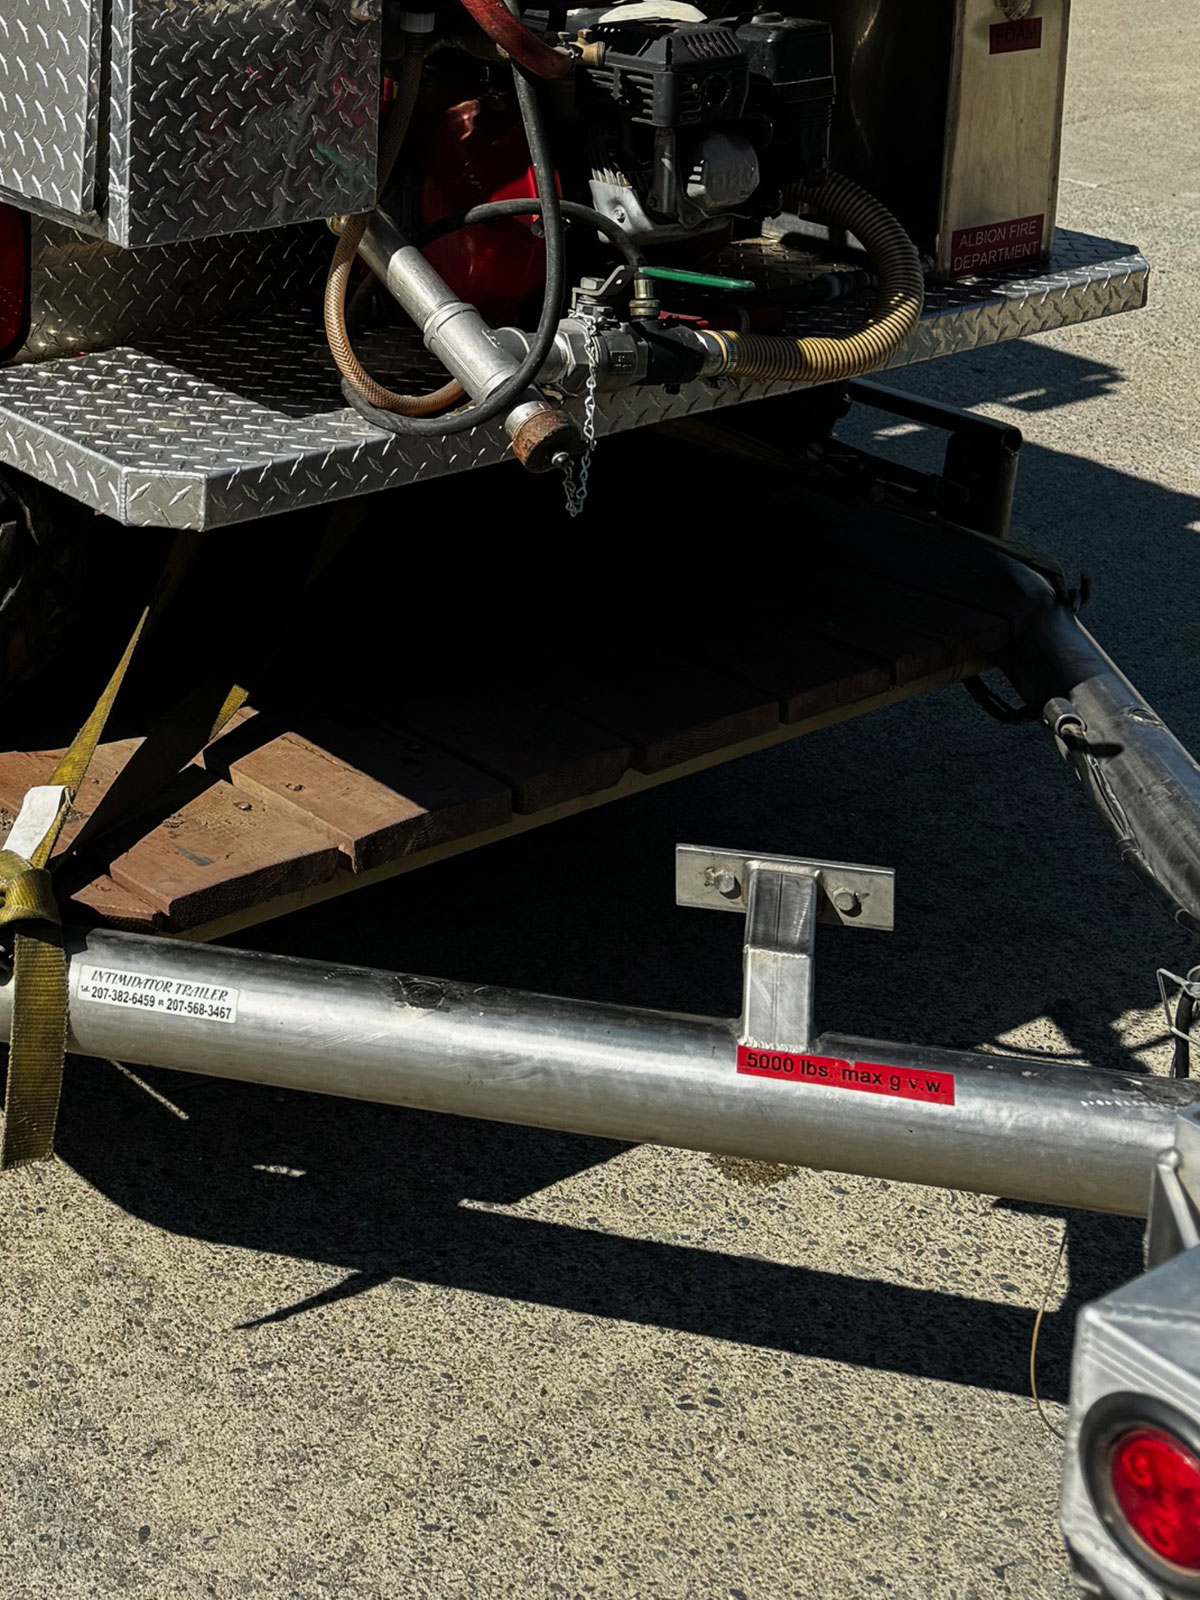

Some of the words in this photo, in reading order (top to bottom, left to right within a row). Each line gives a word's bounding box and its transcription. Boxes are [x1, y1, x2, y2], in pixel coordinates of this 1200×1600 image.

[995, 22, 1037, 46] FOAM
[959, 226, 1006, 249] ALBION
[1008, 220, 1038, 239] FIRE
[953, 240, 1040, 272] DEPARTMENT
[90, 969, 173, 994] INTIMIDATOR
[174, 982, 229, 1003] TRAILER
[91, 986, 156, 1008] 207-382-6459
[166, 997, 232, 1020] 207-568-3467
[746, 1053, 795, 1073] 5000
[800, 1059, 834, 1079] lbs.
[841, 1067, 883, 1085] max
